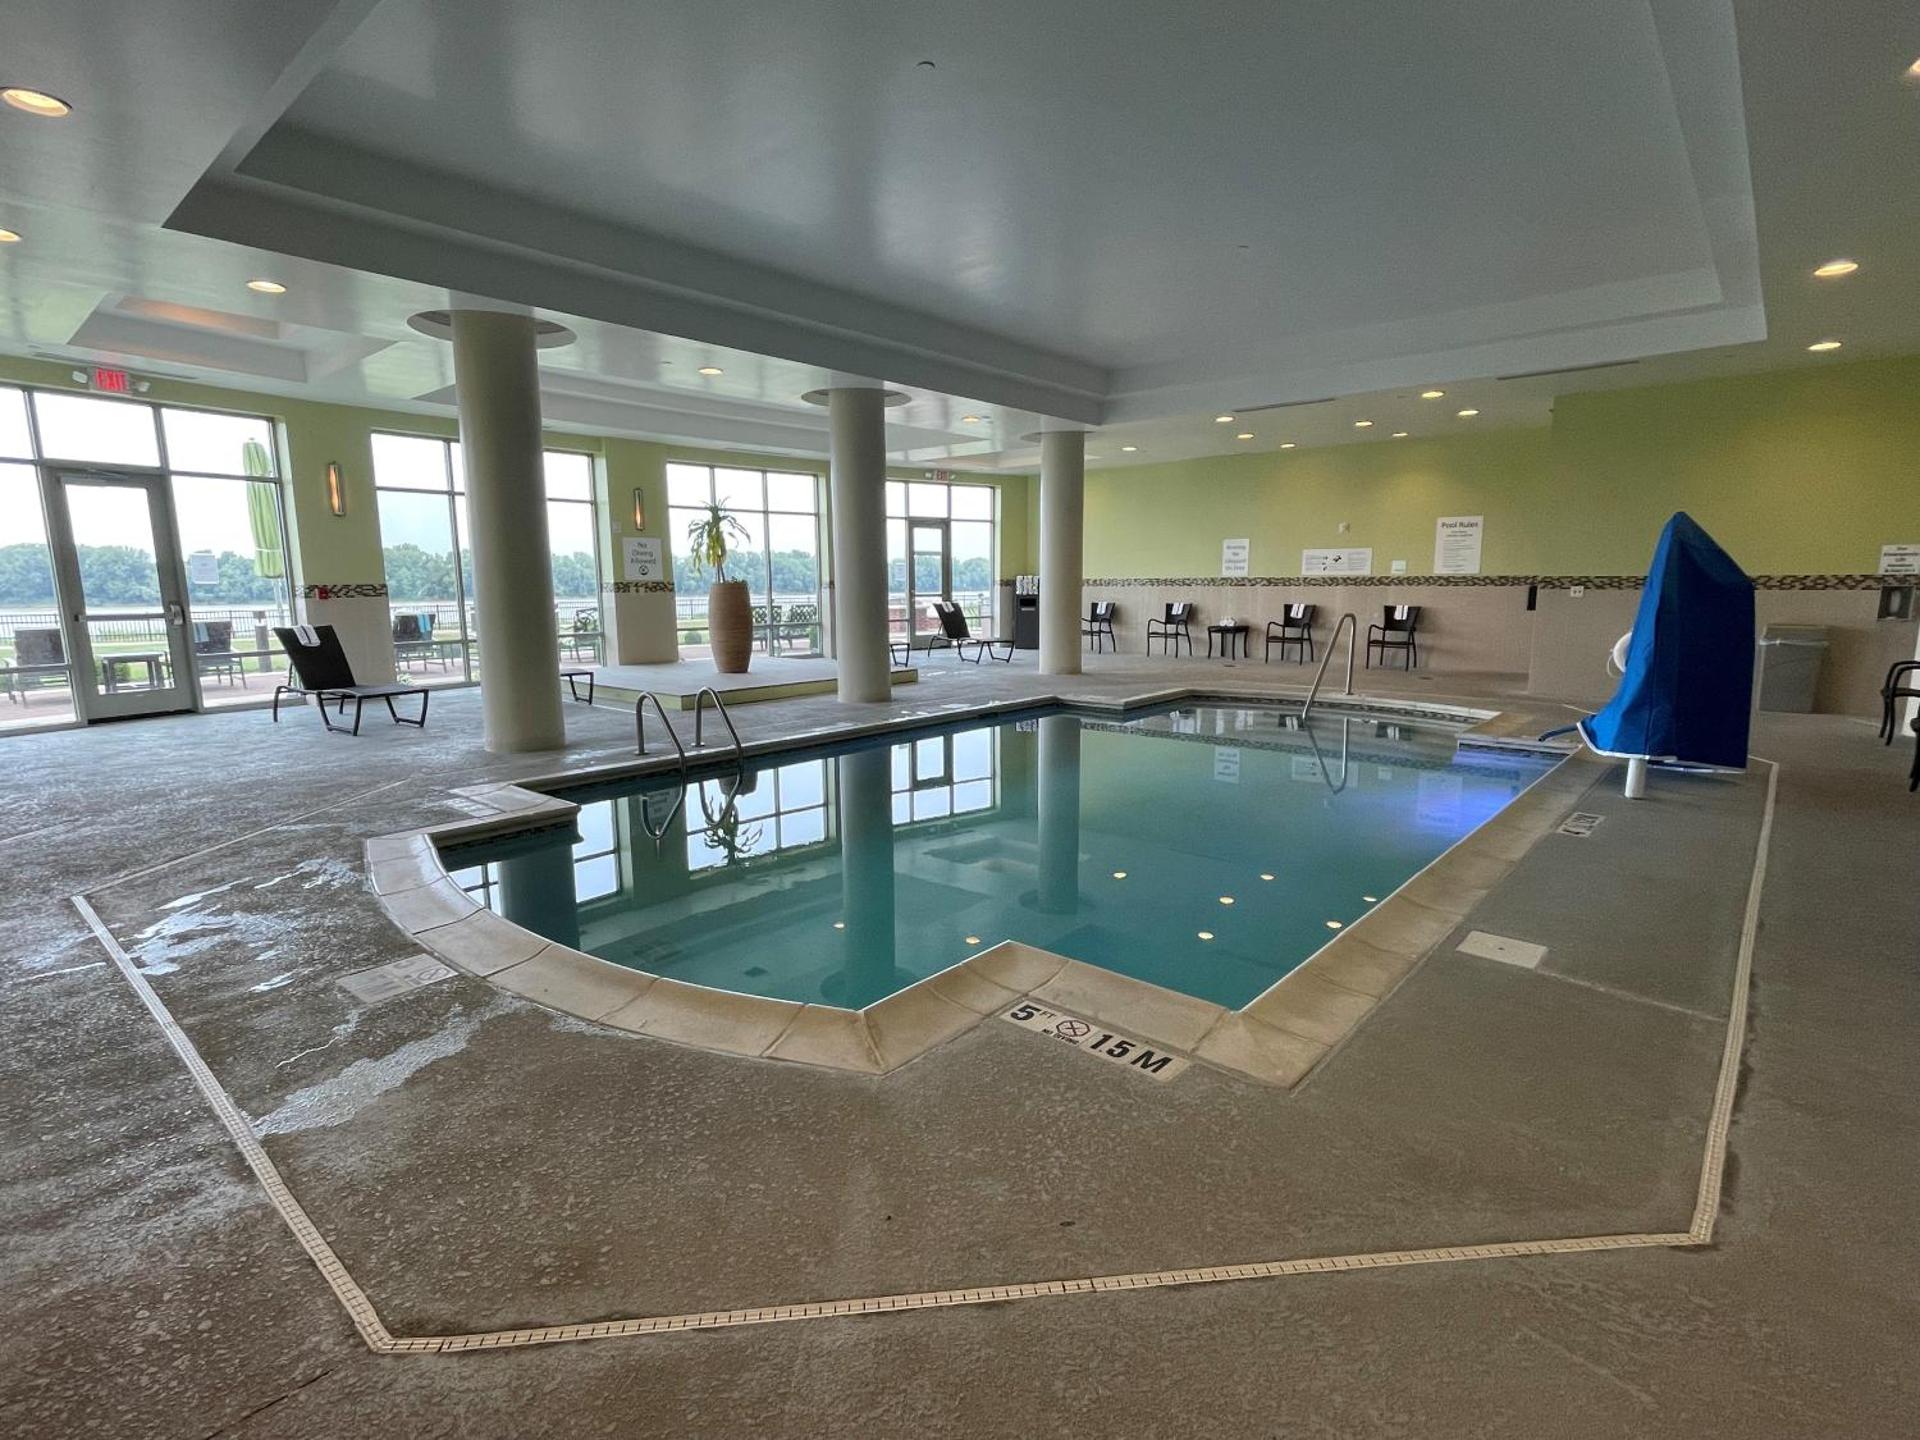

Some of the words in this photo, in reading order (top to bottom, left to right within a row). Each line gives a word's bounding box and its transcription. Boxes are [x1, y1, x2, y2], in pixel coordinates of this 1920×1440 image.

[96, 368, 126, 391] EXIT
[1010, 1004, 1042, 1021] 5
[1039, 1010, 1057, 1019] FT
[1130, 1050, 1174, 1073] M
